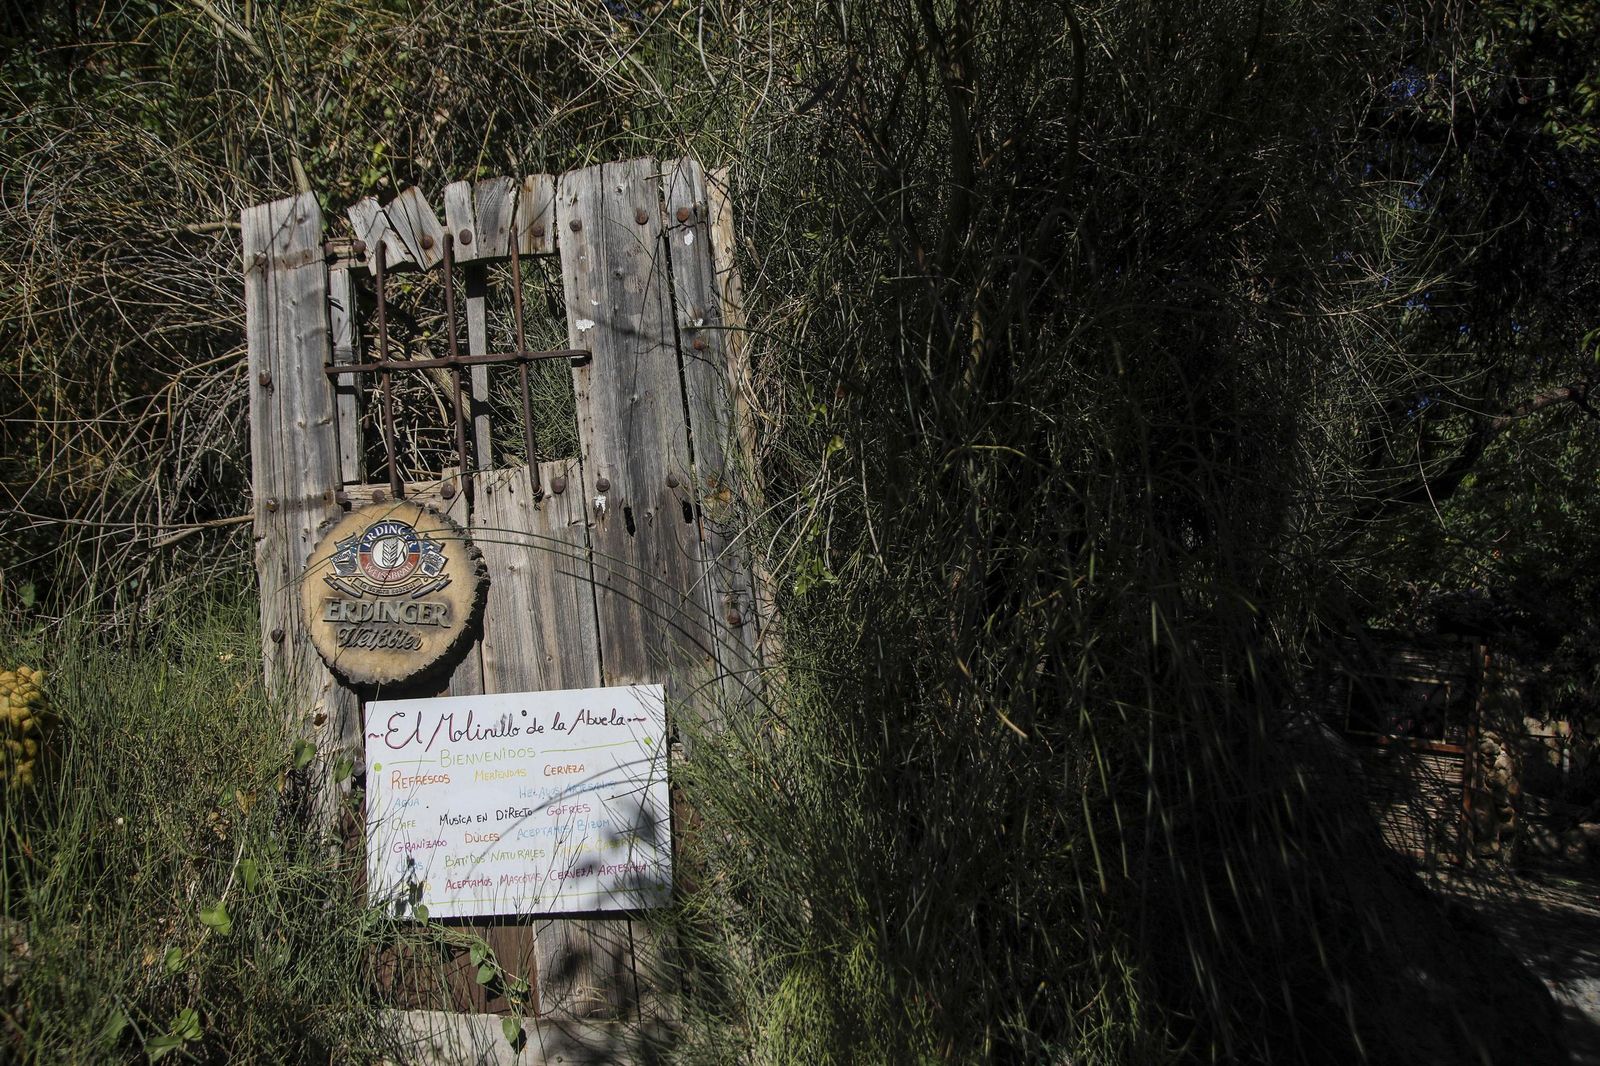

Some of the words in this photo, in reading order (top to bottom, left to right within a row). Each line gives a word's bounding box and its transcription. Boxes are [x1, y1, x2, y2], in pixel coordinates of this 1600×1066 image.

[323, 599, 451, 628] ERDINGER
[384, 710, 423, 750] El
[425, 709, 520, 752] Molinillo
[526, 719, 544, 735] de
[550, 711, 567, 732] la
[567, 708, 626, 736] Abuela
[440, 748, 536, 768] BIENVENIDOS
[391, 770, 451, 790] REFRESCOS
[543, 764, 585, 777] CERVEZA
[394, 798, 420, 807] AGUA
[392, 816, 417, 831] CAFE
[439, 814, 473, 826] MUSICA
[476, 814, 488, 822] EN
[496, 808, 534, 821] DIRECTO
[547, 803, 591, 816] GOFRES
[393, 839, 448, 854] GRANIZADO
[464, 832, 501, 844] DULCES
[444, 855, 486, 868] BATIDOS
[491, 849, 546, 862] NATURALES
[445, 879, 493, 893] ACEPTAMOS
[500, 873, 543, 887] MASCOTAS
[549, 864, 594, 881] CERVEZA
